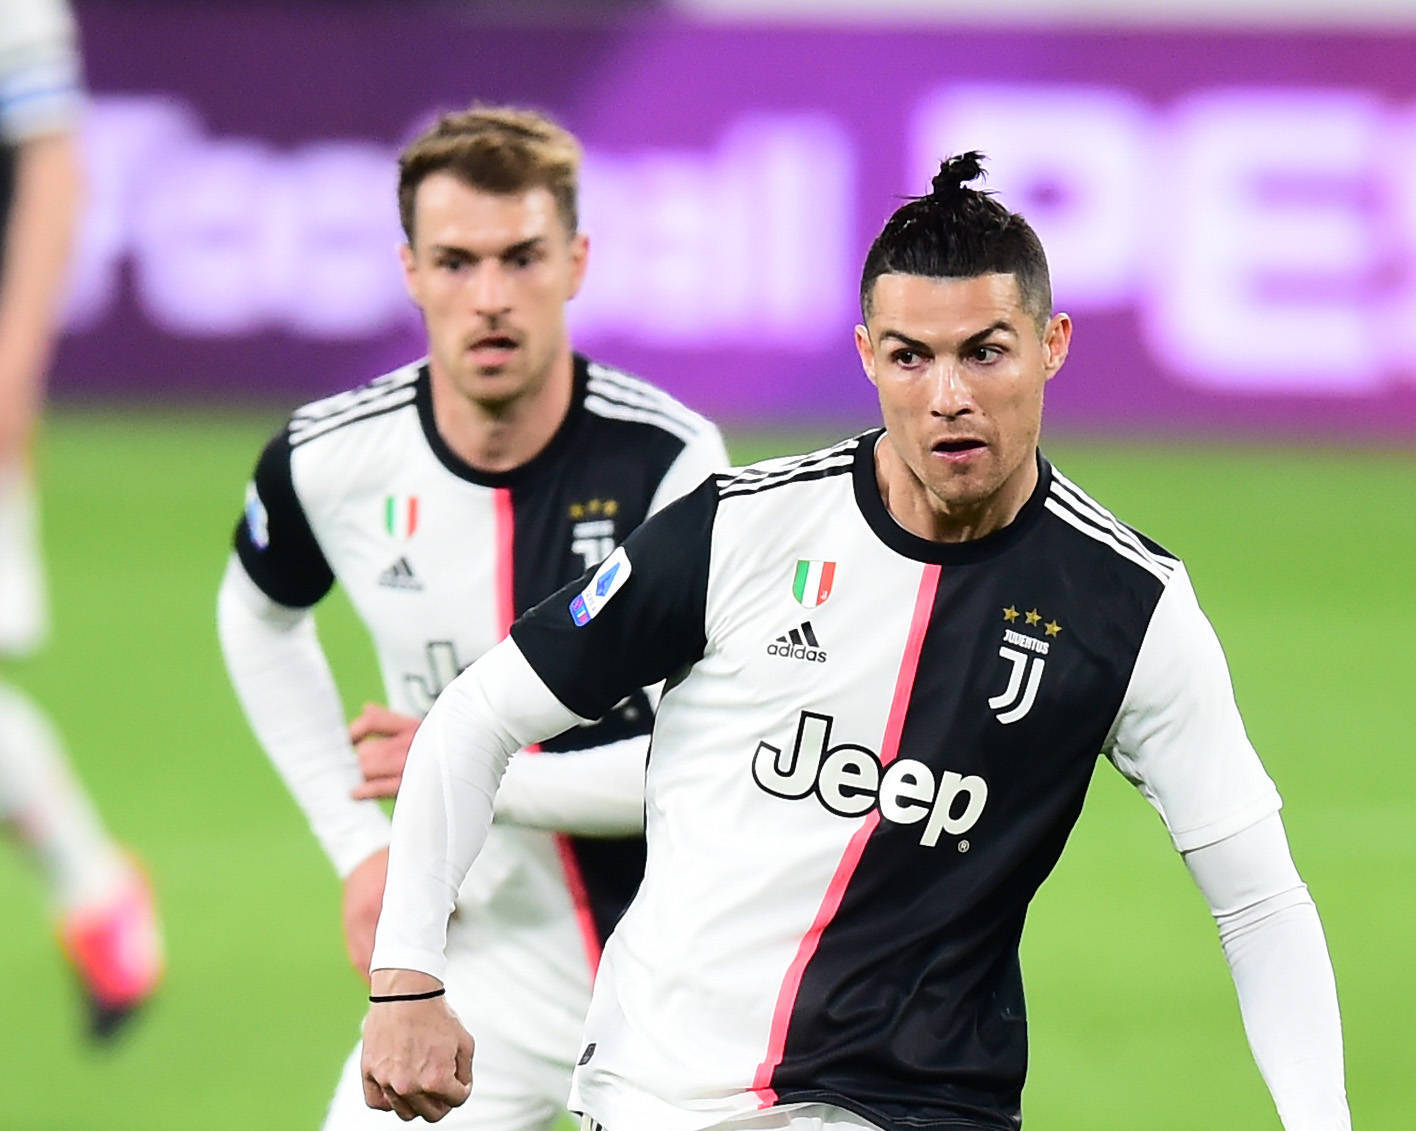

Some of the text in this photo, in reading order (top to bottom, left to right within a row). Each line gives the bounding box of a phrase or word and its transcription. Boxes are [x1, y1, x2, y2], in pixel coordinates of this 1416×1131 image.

[766, 642, 828, 664] adidas
[1003, 628, 1049, 655] JUVENTUS
[751, 710, 989, 848] Jeep
